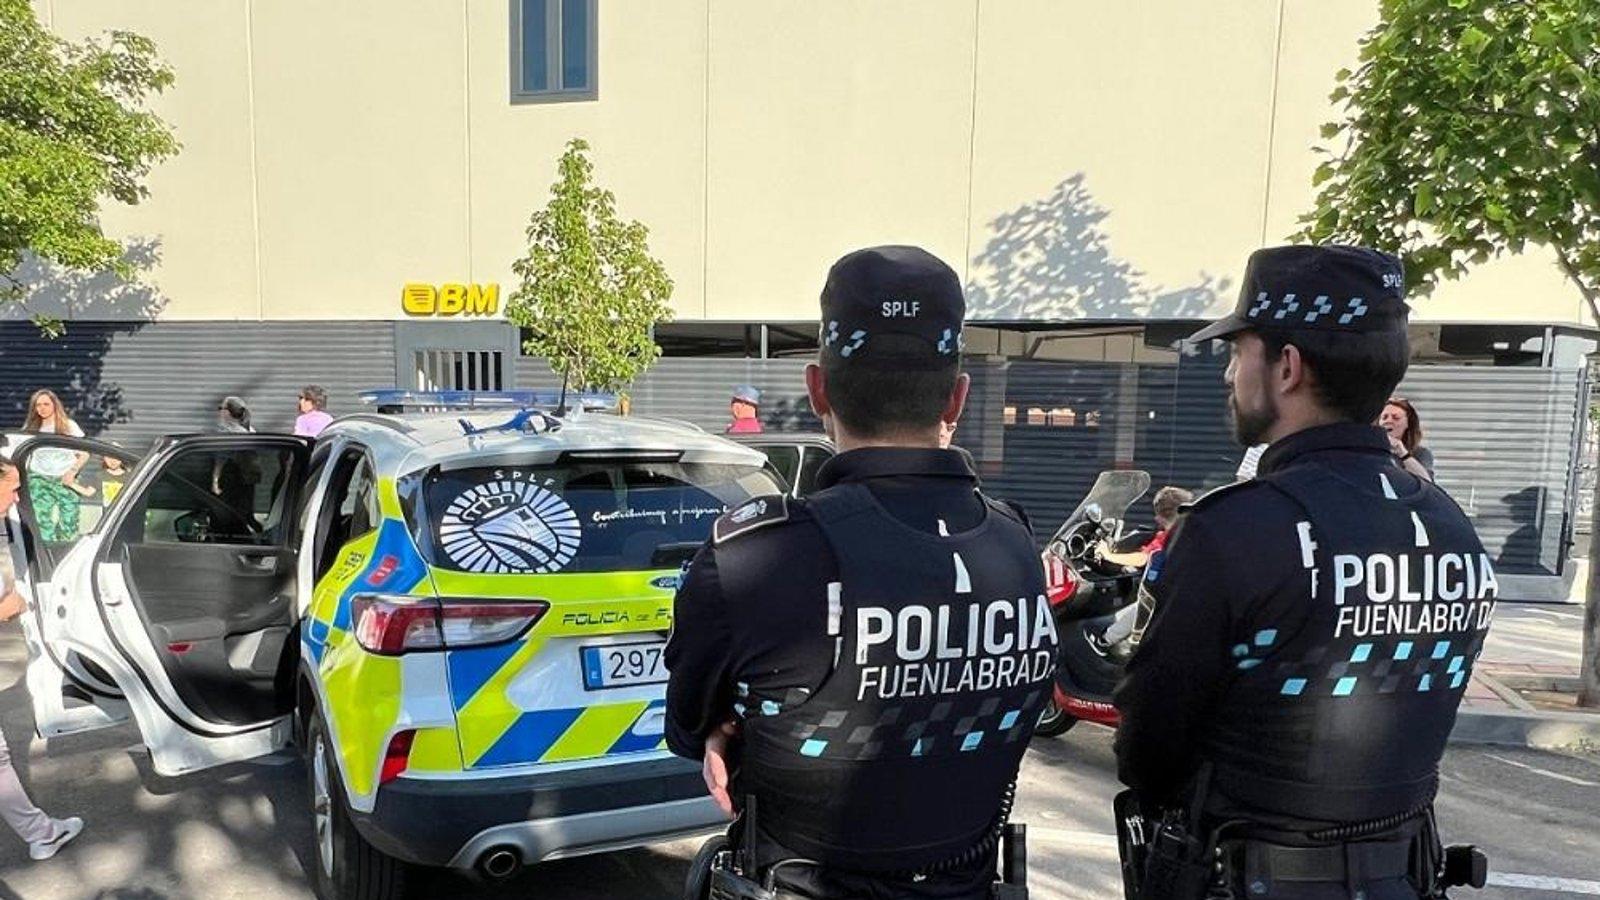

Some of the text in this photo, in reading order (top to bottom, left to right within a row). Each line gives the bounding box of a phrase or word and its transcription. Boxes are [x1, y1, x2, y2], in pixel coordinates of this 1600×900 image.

[438, 283, 500, 316] BM
[882, 301, 920, 317] SPLF
[494, 470, 556, 486] SPLF
[1333, 553, 1498, 605] POLICIA
[562, 612, 629, 625] POLICIA
[856, 595, 1058, 664] POLICIA
